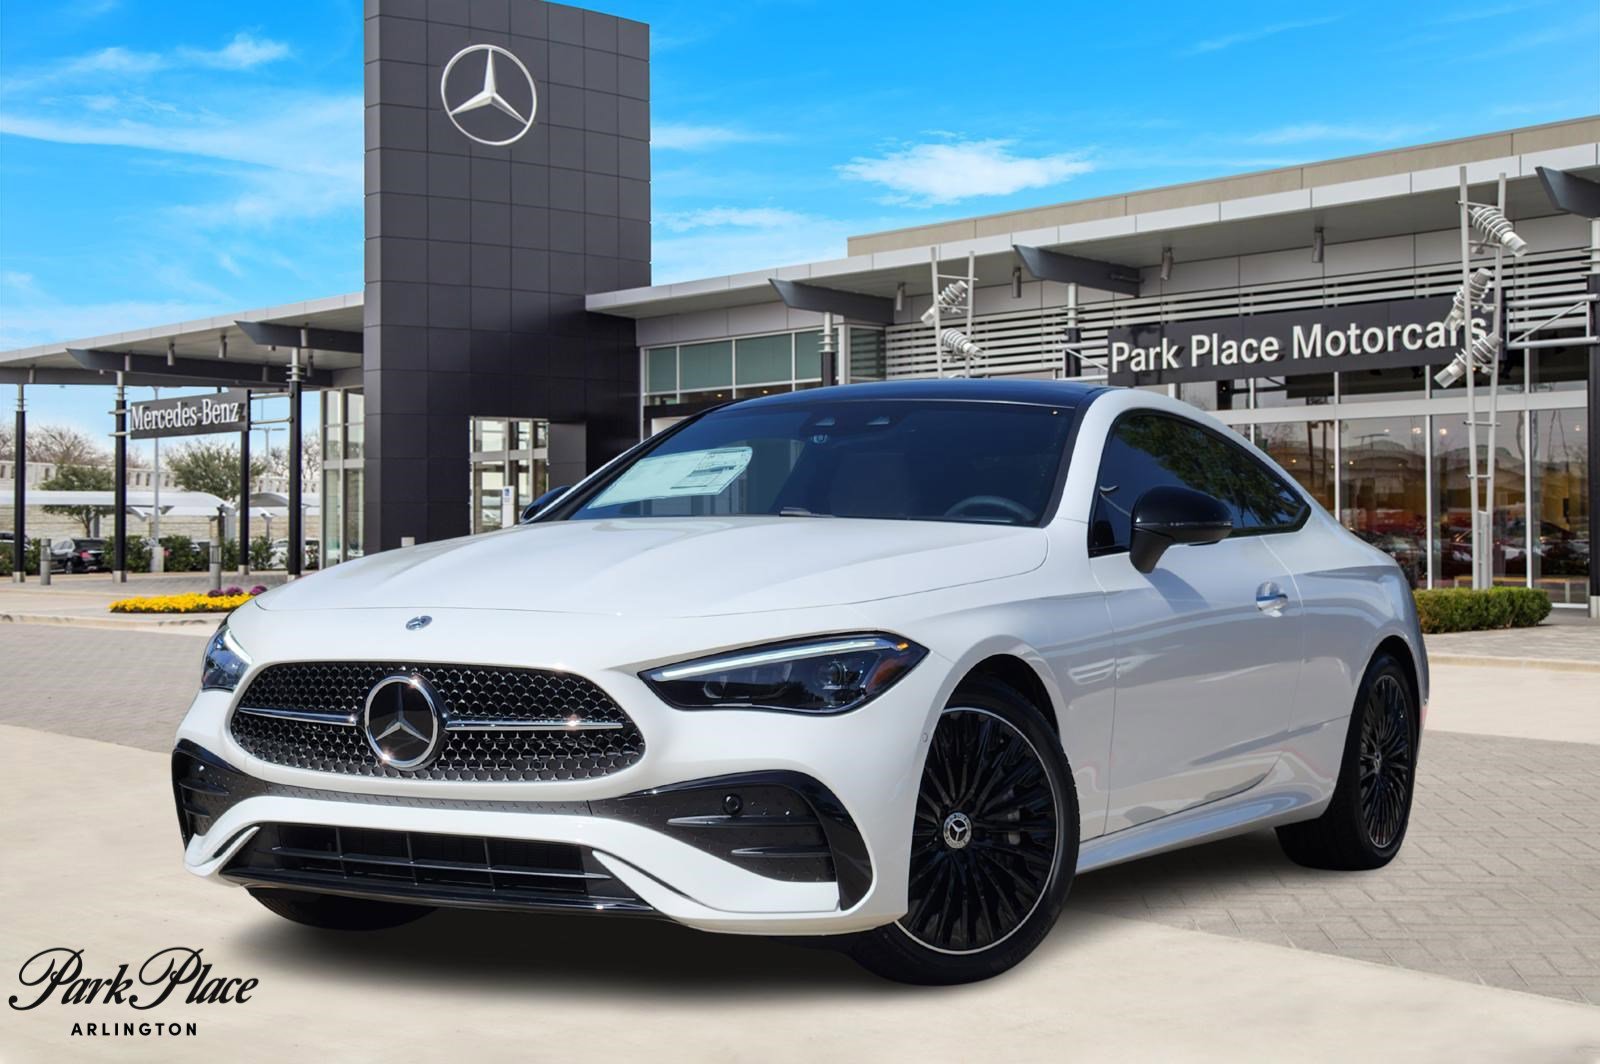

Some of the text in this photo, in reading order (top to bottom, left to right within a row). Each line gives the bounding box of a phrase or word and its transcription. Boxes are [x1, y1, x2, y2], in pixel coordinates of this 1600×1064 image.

[1110, 338, 1180, 373] Park
[1190, 332, 1280, 367] Place
[131, 398, 239, 431] Mercedes-Benz
